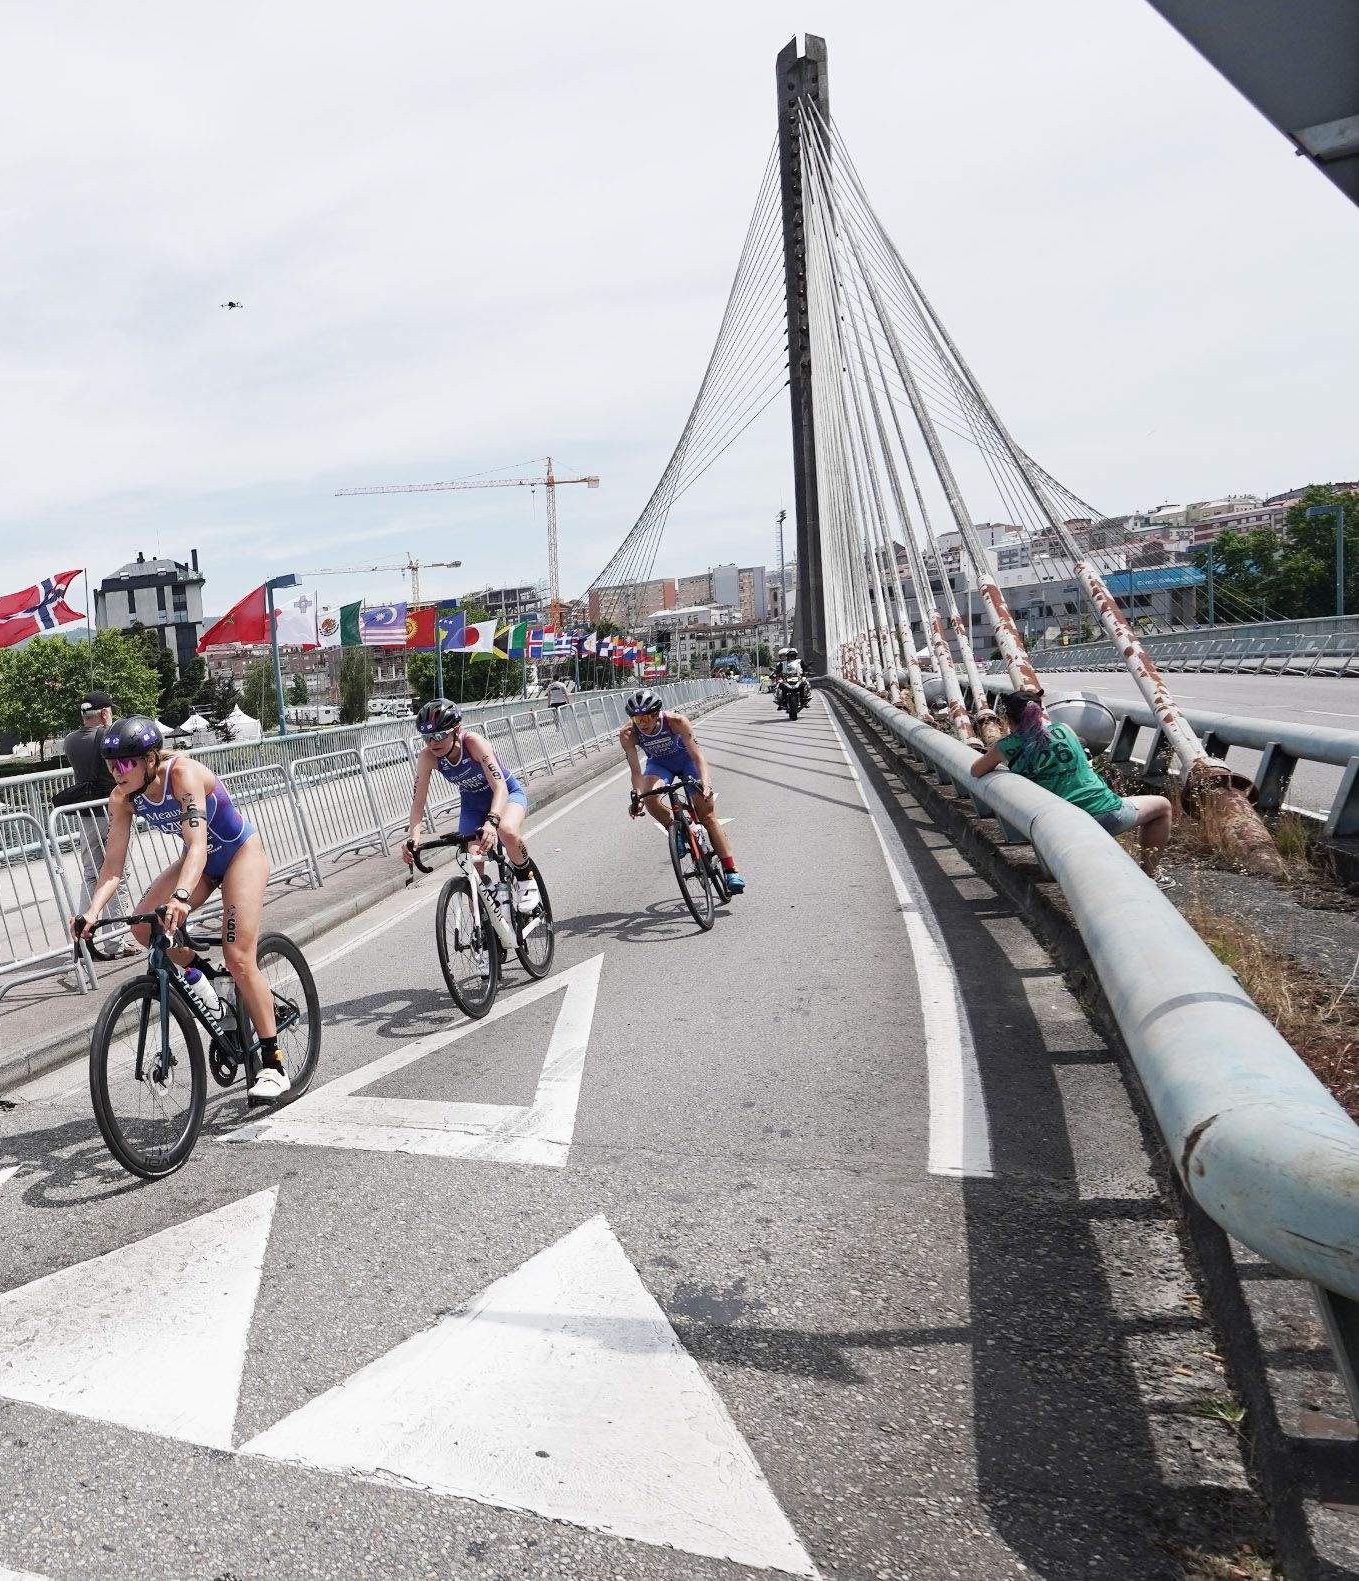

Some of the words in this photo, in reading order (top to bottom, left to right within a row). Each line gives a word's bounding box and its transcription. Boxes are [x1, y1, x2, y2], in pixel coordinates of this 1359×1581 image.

[145, 808, 183, 822] Meaux
[226, 918, 236, 943] 66
[174, 970, 225, 1036] SPECIALIZED
